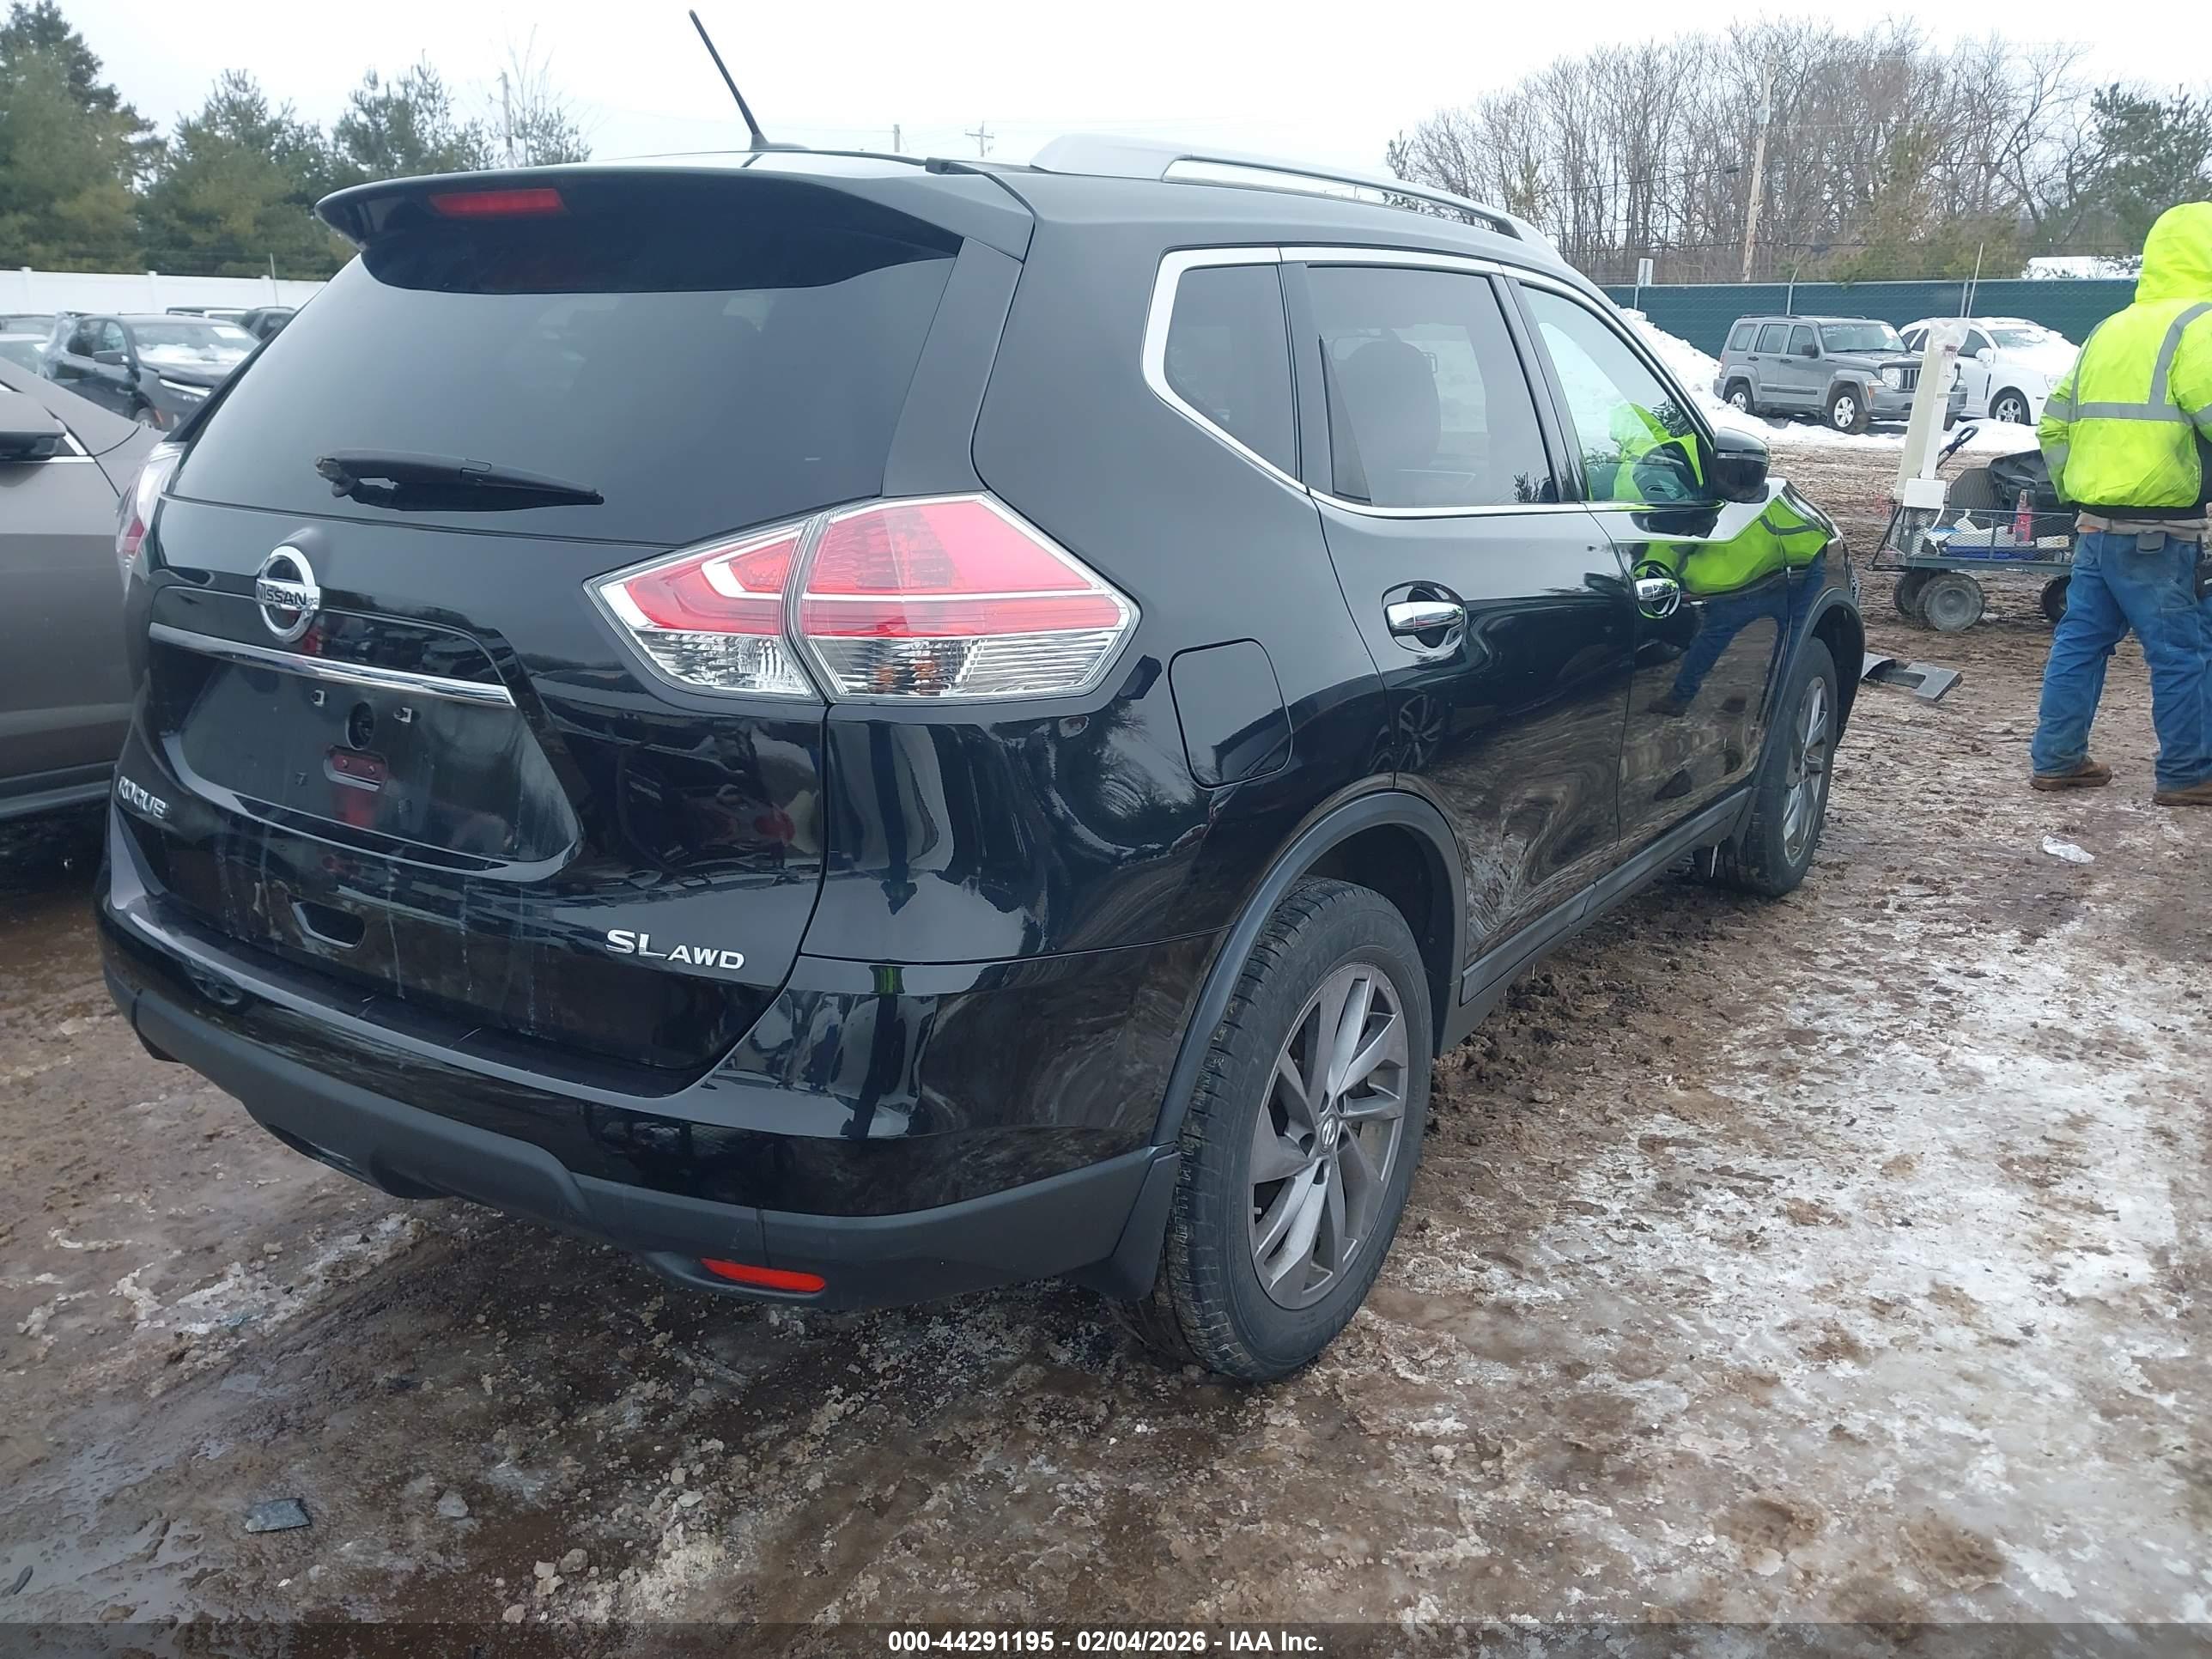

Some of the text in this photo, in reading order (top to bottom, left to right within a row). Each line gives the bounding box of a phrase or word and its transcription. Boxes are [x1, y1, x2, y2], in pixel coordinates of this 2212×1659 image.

[258, 582, 307, 606] NISSAN
[118, 775, 167, 819] ROGUE
[605, 929, 744, 969] SL AWD
